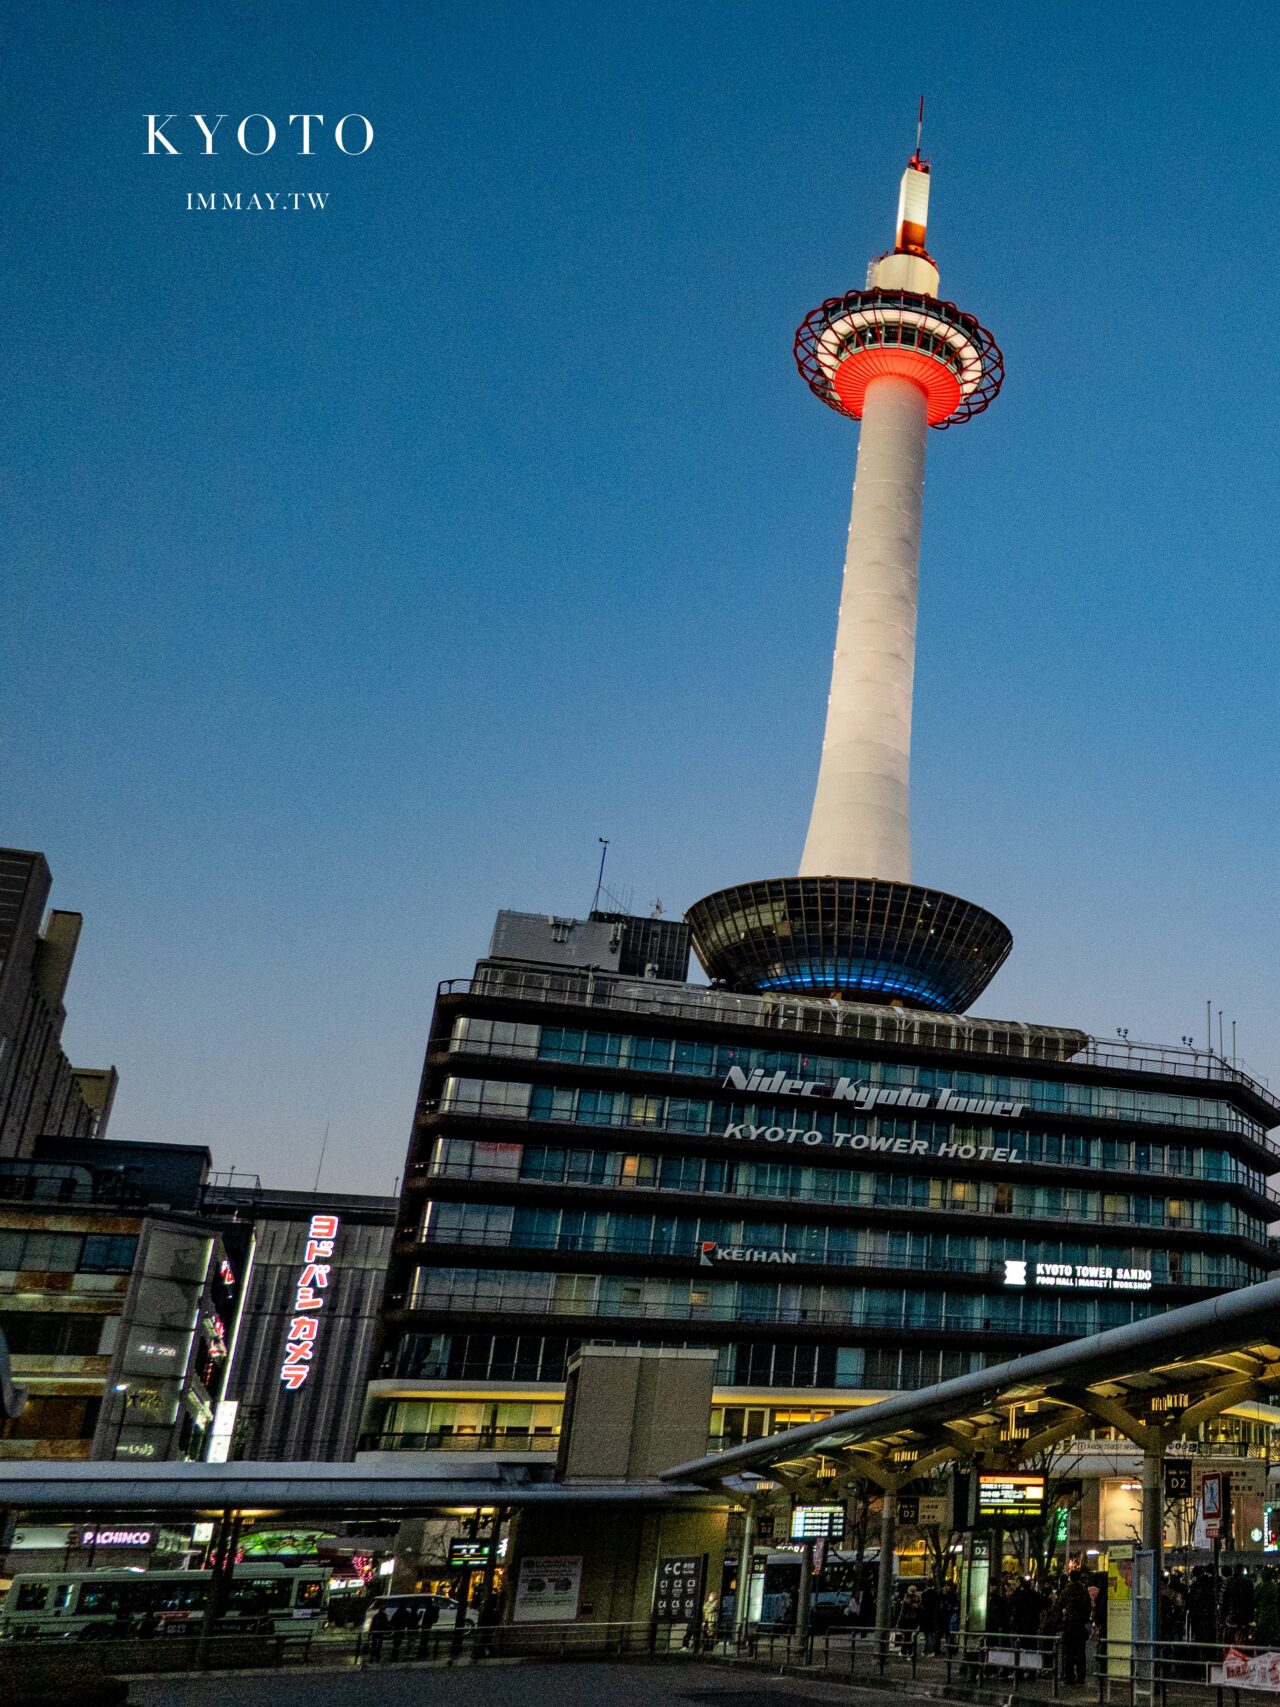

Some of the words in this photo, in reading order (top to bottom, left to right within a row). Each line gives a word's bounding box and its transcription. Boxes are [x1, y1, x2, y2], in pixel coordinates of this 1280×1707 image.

[722, 1065, 826, 1098] Nidec
[832, 1077, 930, 1110] Kyoto
[936, 1088, 1030, 1118] Tower
[723, 1123, 822, 1145] KYOTO
[834, 1133, 928, 1155] TOWER
[937, 1142, 1024, 1163] HOTEL
[717, 1248, 797, 1264] KEIHAN
[1036, 1263, 1072, 1276] KYOTO
[1075, 1265, 1112, 1279] TOWER
[1116, 1268, 1152, 1281] SANDO
[1036, 1276, 1055, 1286] FOOD
[1056, 1277, 1074, 1287] HALL
[1078, 1278, 1107, 1288] MARKET
[1113, 1280, 1152, 1290] WORKSHOP
[280, 1215, 338, 1390] ヨドバシカメラ
[1171, 1479, 1186, 1489] D2
[82, 1531, 150, 1545] PACHINCO
[975, 1547, 987, 1555] D2
[673, 1562, 681, 1575] C
[660, 1580, 668, 1588] C1
[685, 1599, 694, 1608] C6
